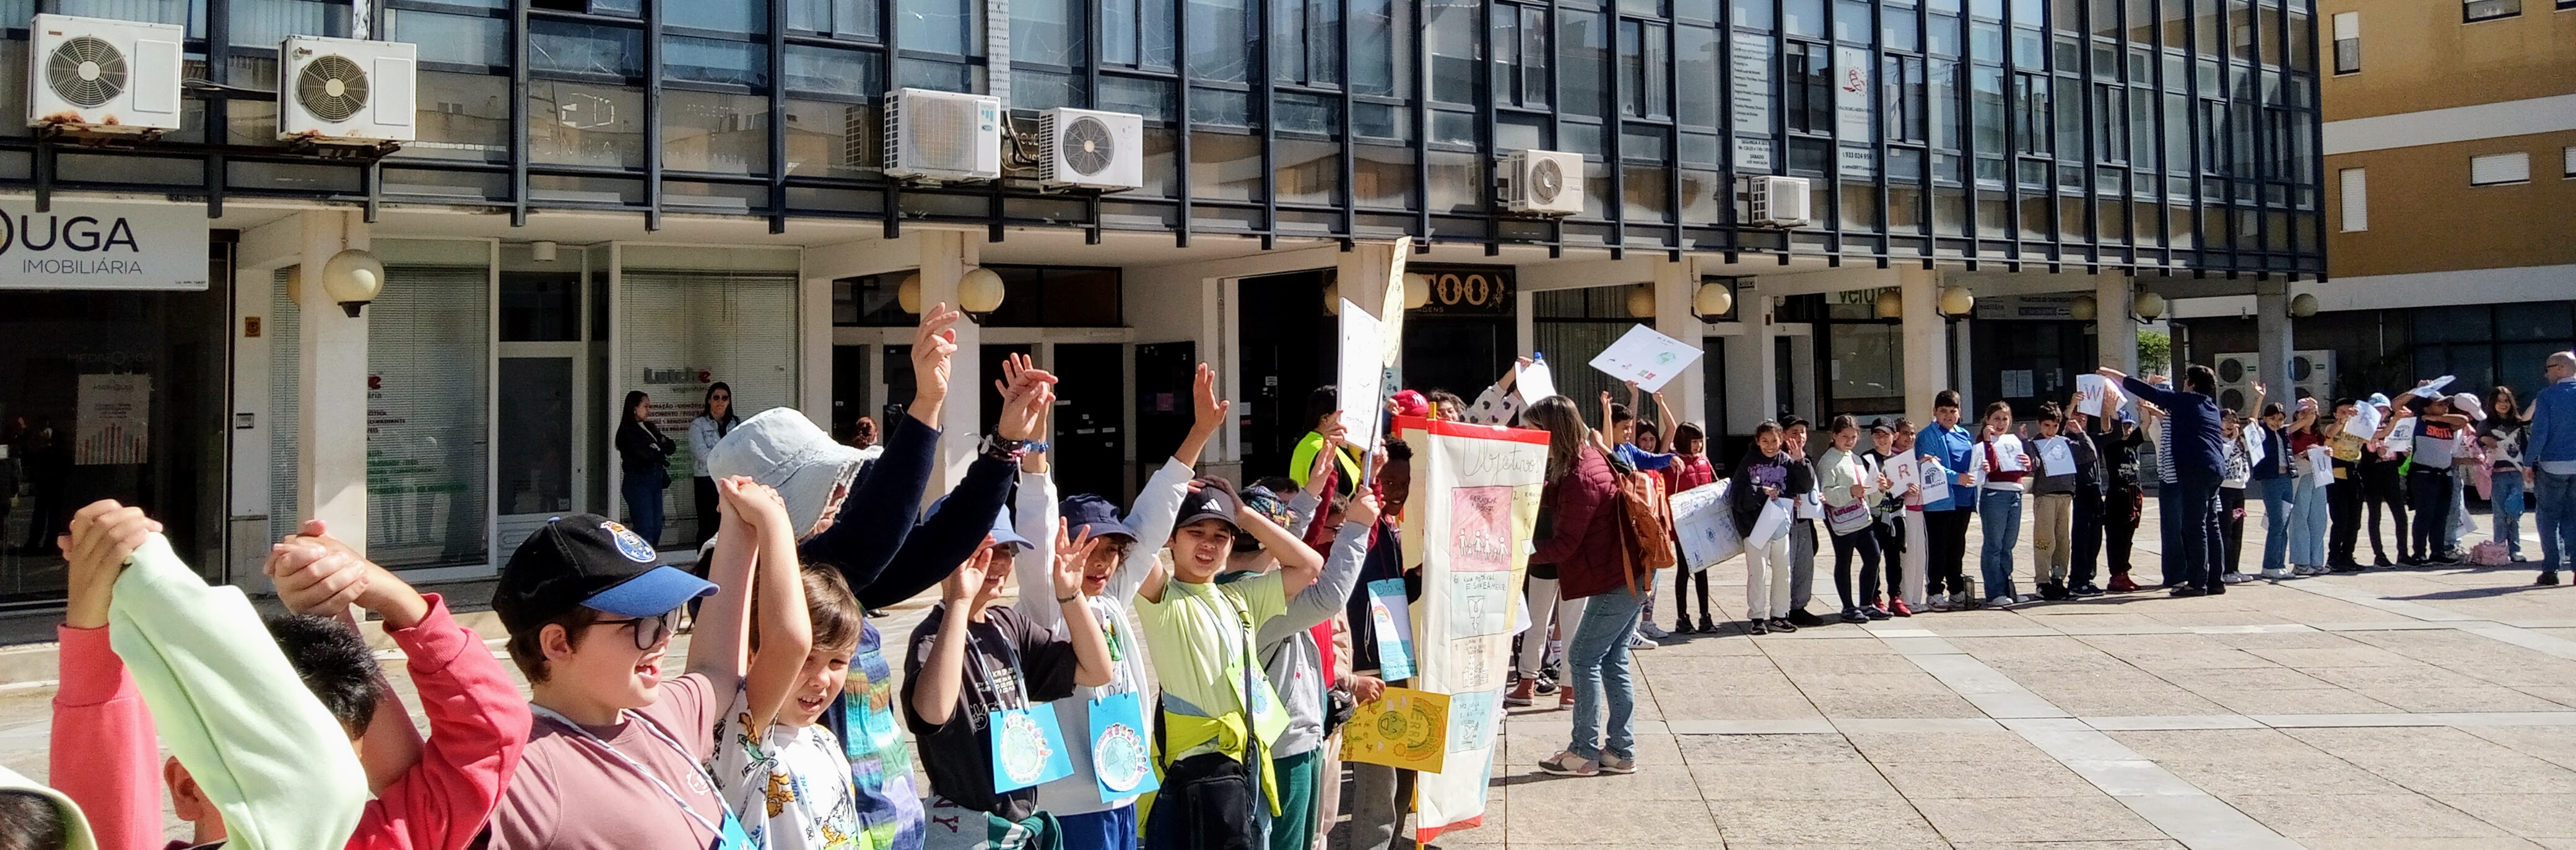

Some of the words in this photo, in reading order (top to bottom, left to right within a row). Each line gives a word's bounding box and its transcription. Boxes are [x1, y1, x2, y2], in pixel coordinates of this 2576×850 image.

[0, 207, 139, 255] UGA
[23, 258, 142, 275] IMOBILIÁRIA
[2084, 383, 2102, 402] W
[1897, 463, 1911, 479] R
[1454, 575, 1458, 584] 6
